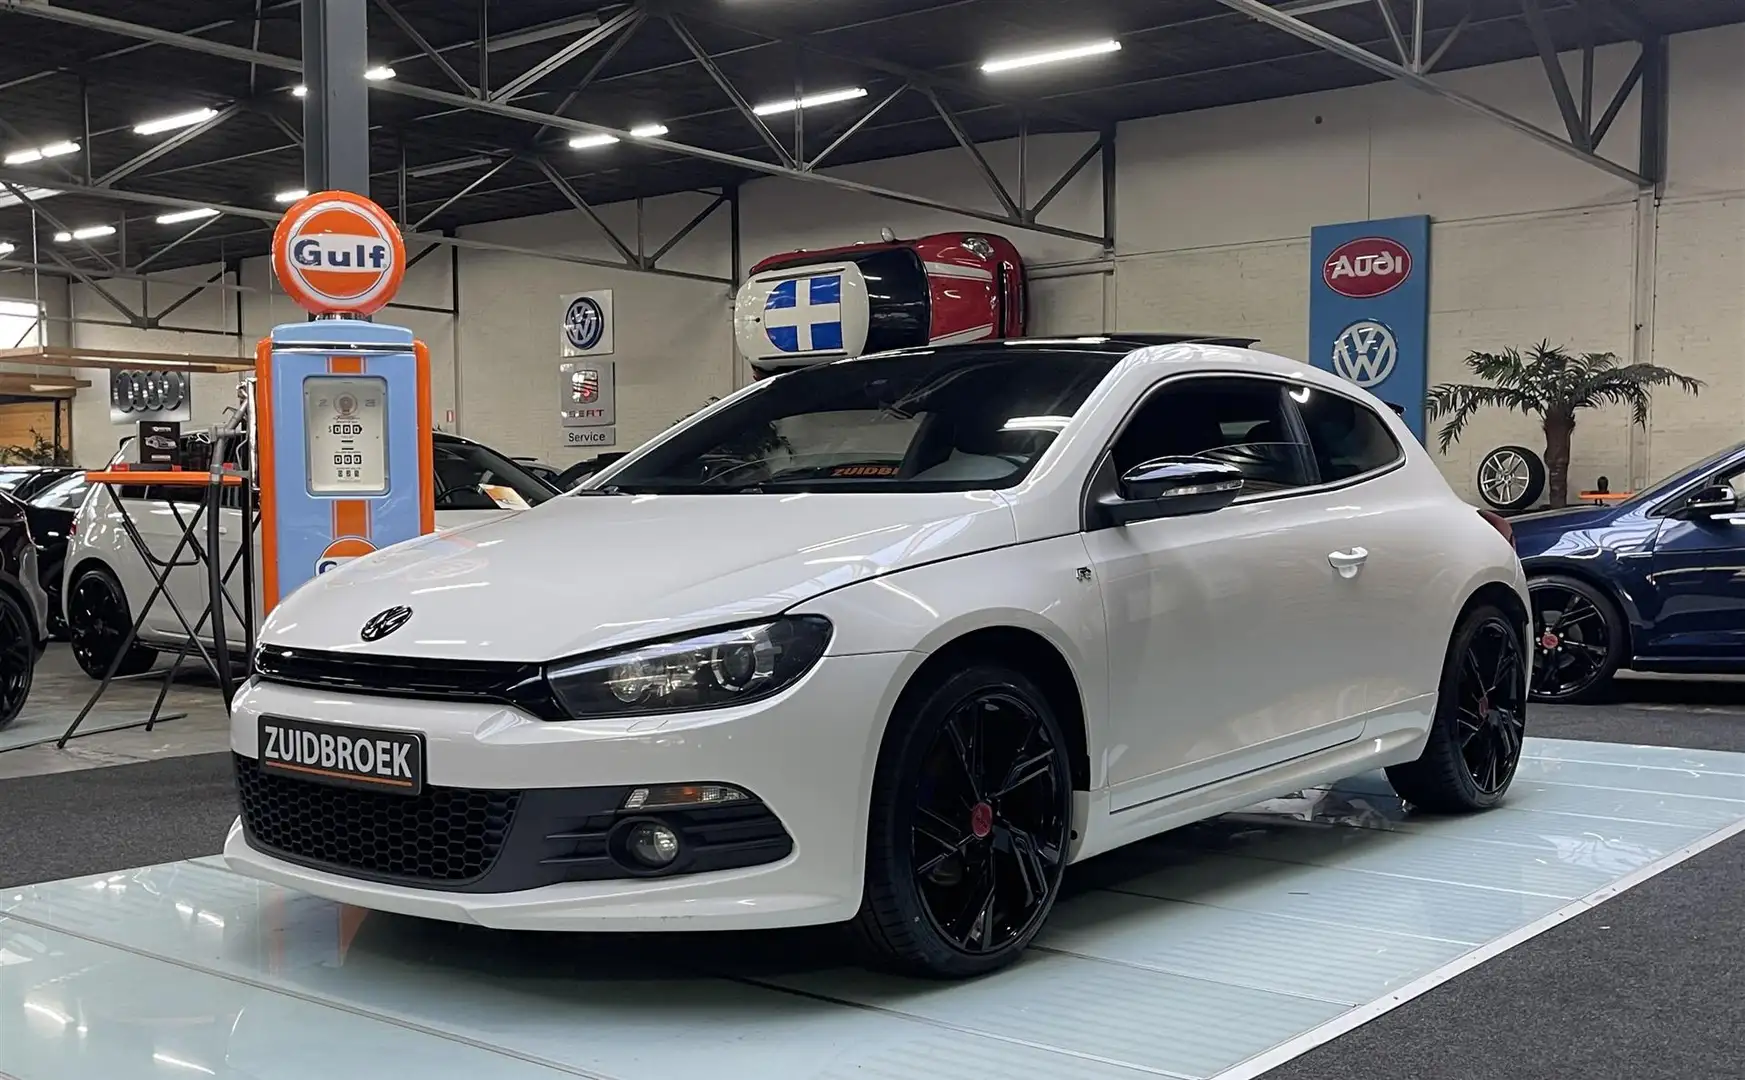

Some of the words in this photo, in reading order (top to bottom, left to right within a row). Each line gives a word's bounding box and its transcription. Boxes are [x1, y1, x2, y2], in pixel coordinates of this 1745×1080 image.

[294, 239, 385, 268] Gulf
[569, 409, 605, 417] SEAT
[568, 431, 605, 442] Service
[831, 467, 899, 477] ZUIDB
[264, 725, 412, 778] ZUIDBROEK
